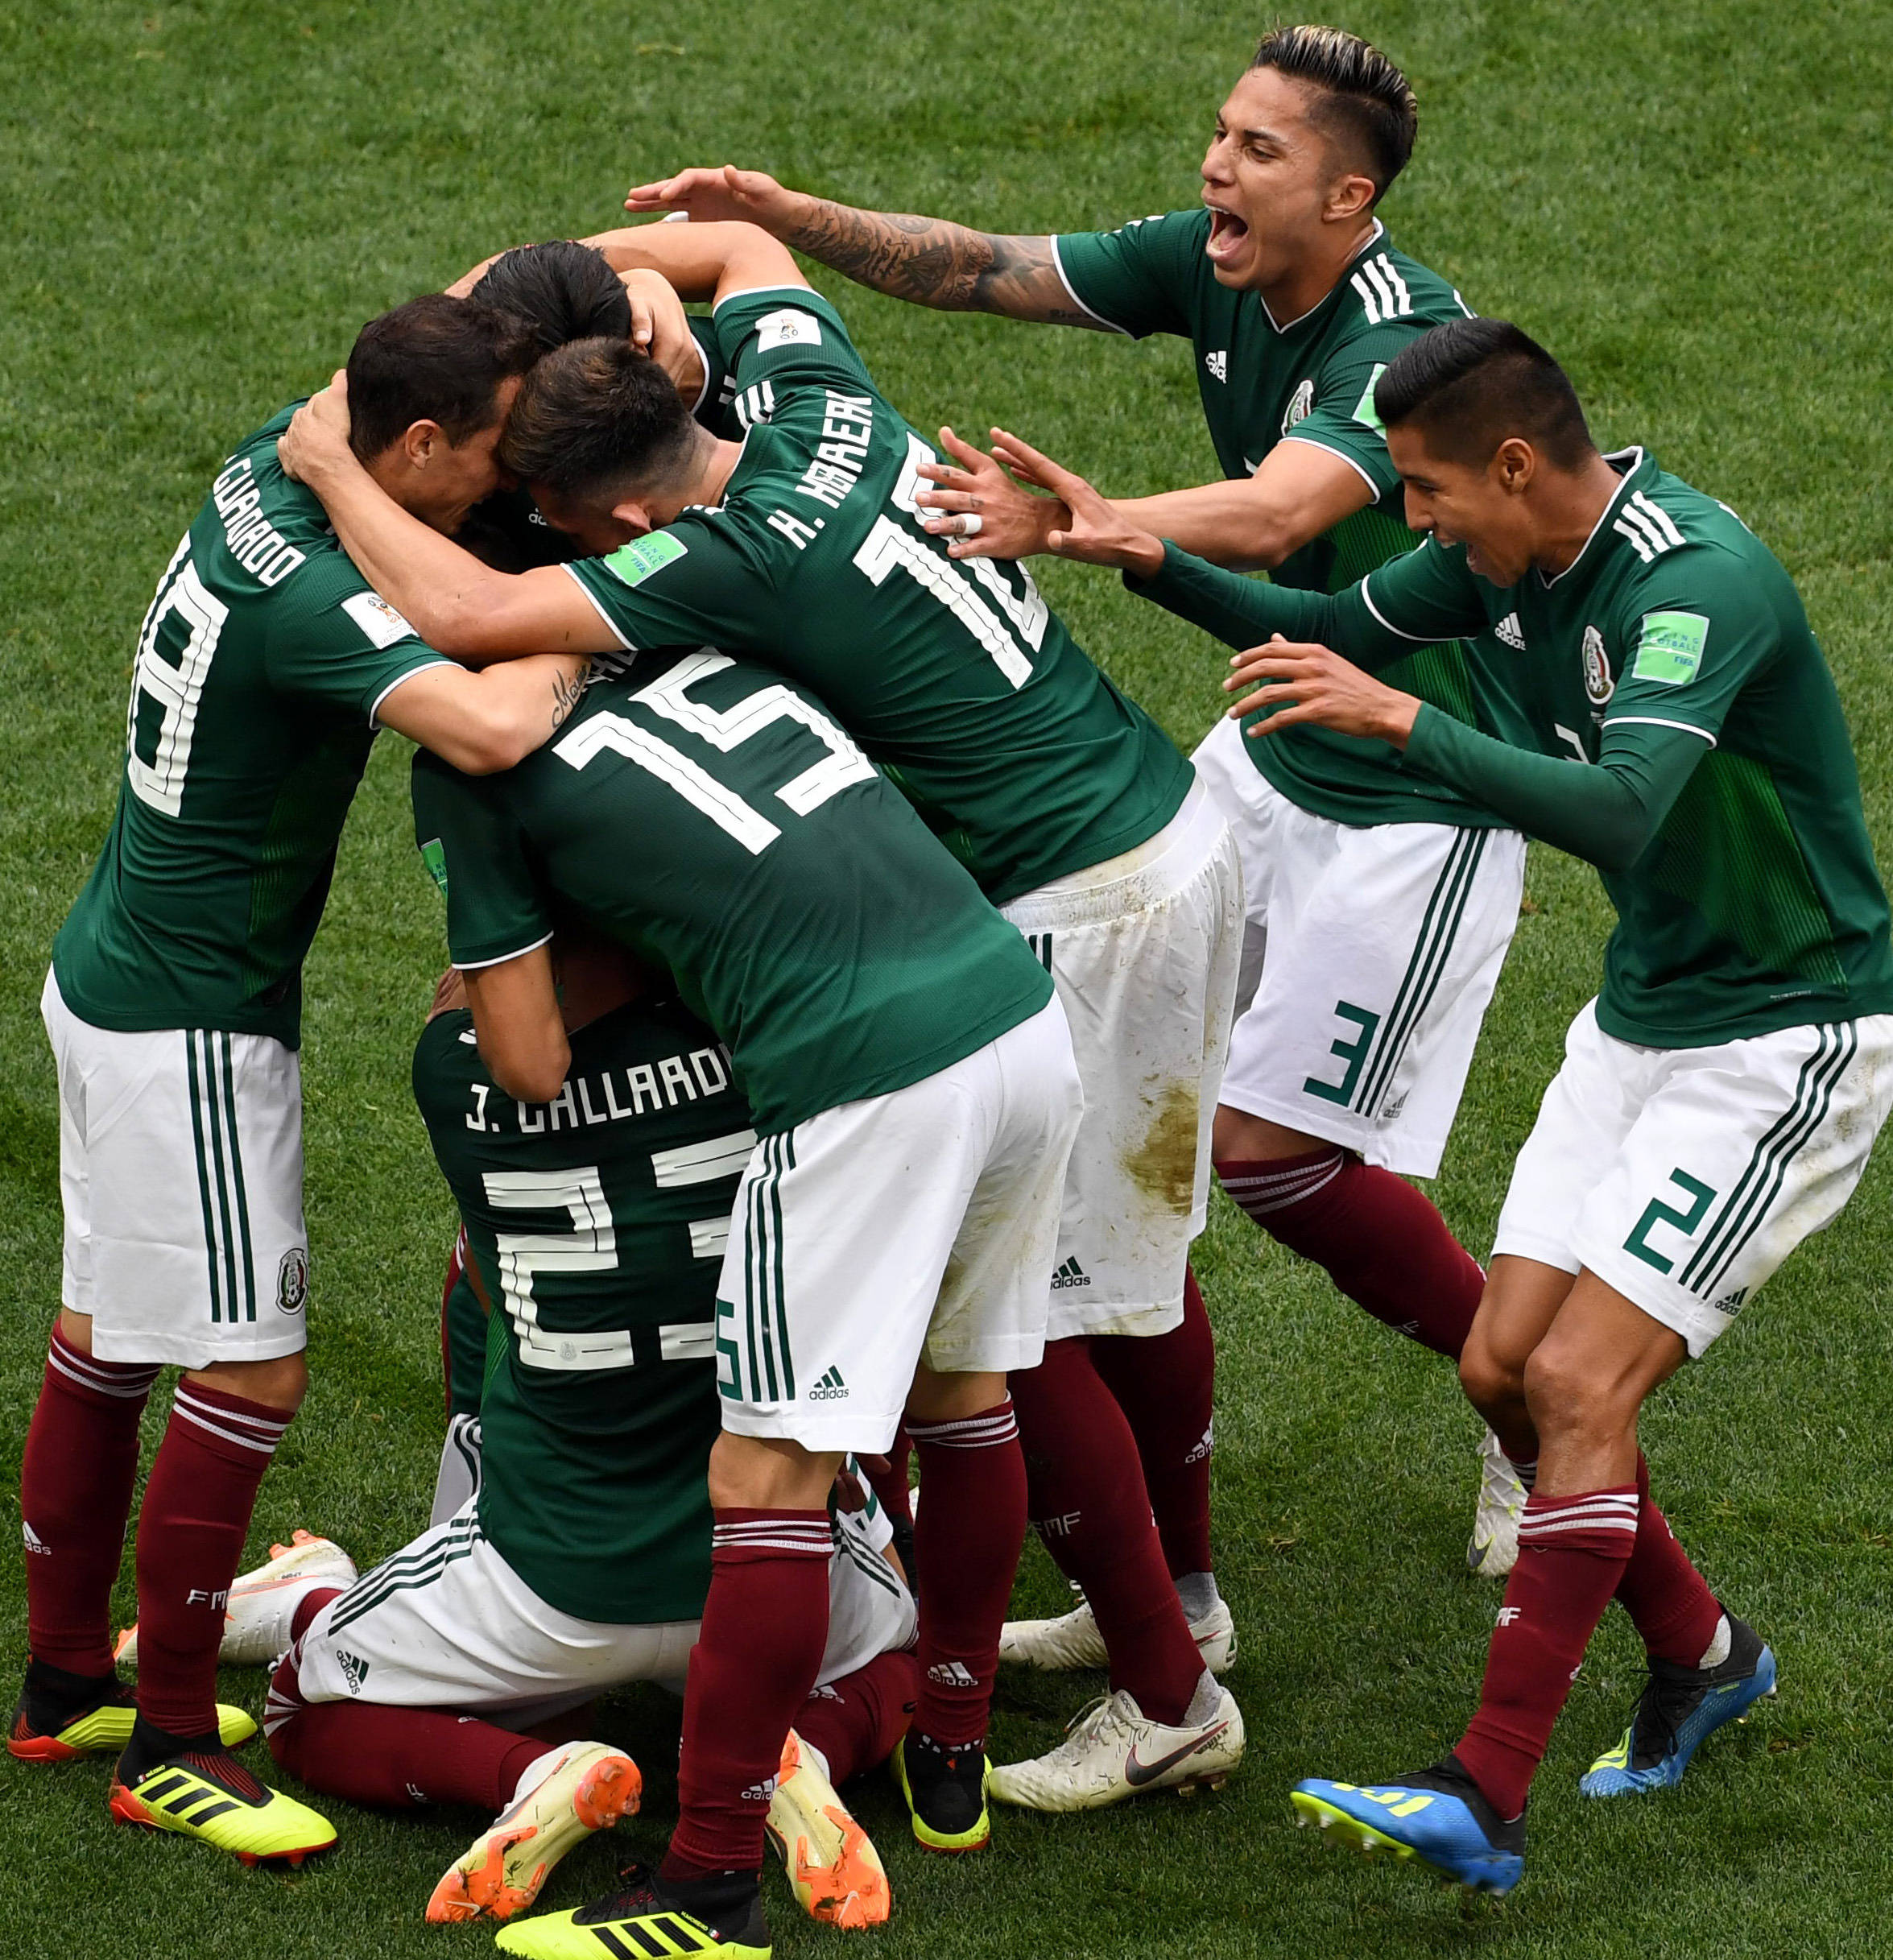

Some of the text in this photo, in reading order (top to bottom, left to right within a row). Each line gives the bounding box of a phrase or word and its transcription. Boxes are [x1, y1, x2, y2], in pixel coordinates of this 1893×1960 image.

[767, 509, 825, 551] H.
[630, 557, 646, 574] FIFA
[1674, 655, 1694, 667] FIFA
[552, 647, 879, 855] 15
[1303, 1000, 1381, 1108] 3
[465, 1044, 731, 1134] J. GALLARD
[1623, 1166, 1717, 1276] 2
[808, 1387, 849, 1400] adidas
[185, 1589, 229, 1611] FM
[337, 1649, 361, 1695] adidas
[928, 1670, 979, 1687] adidas
